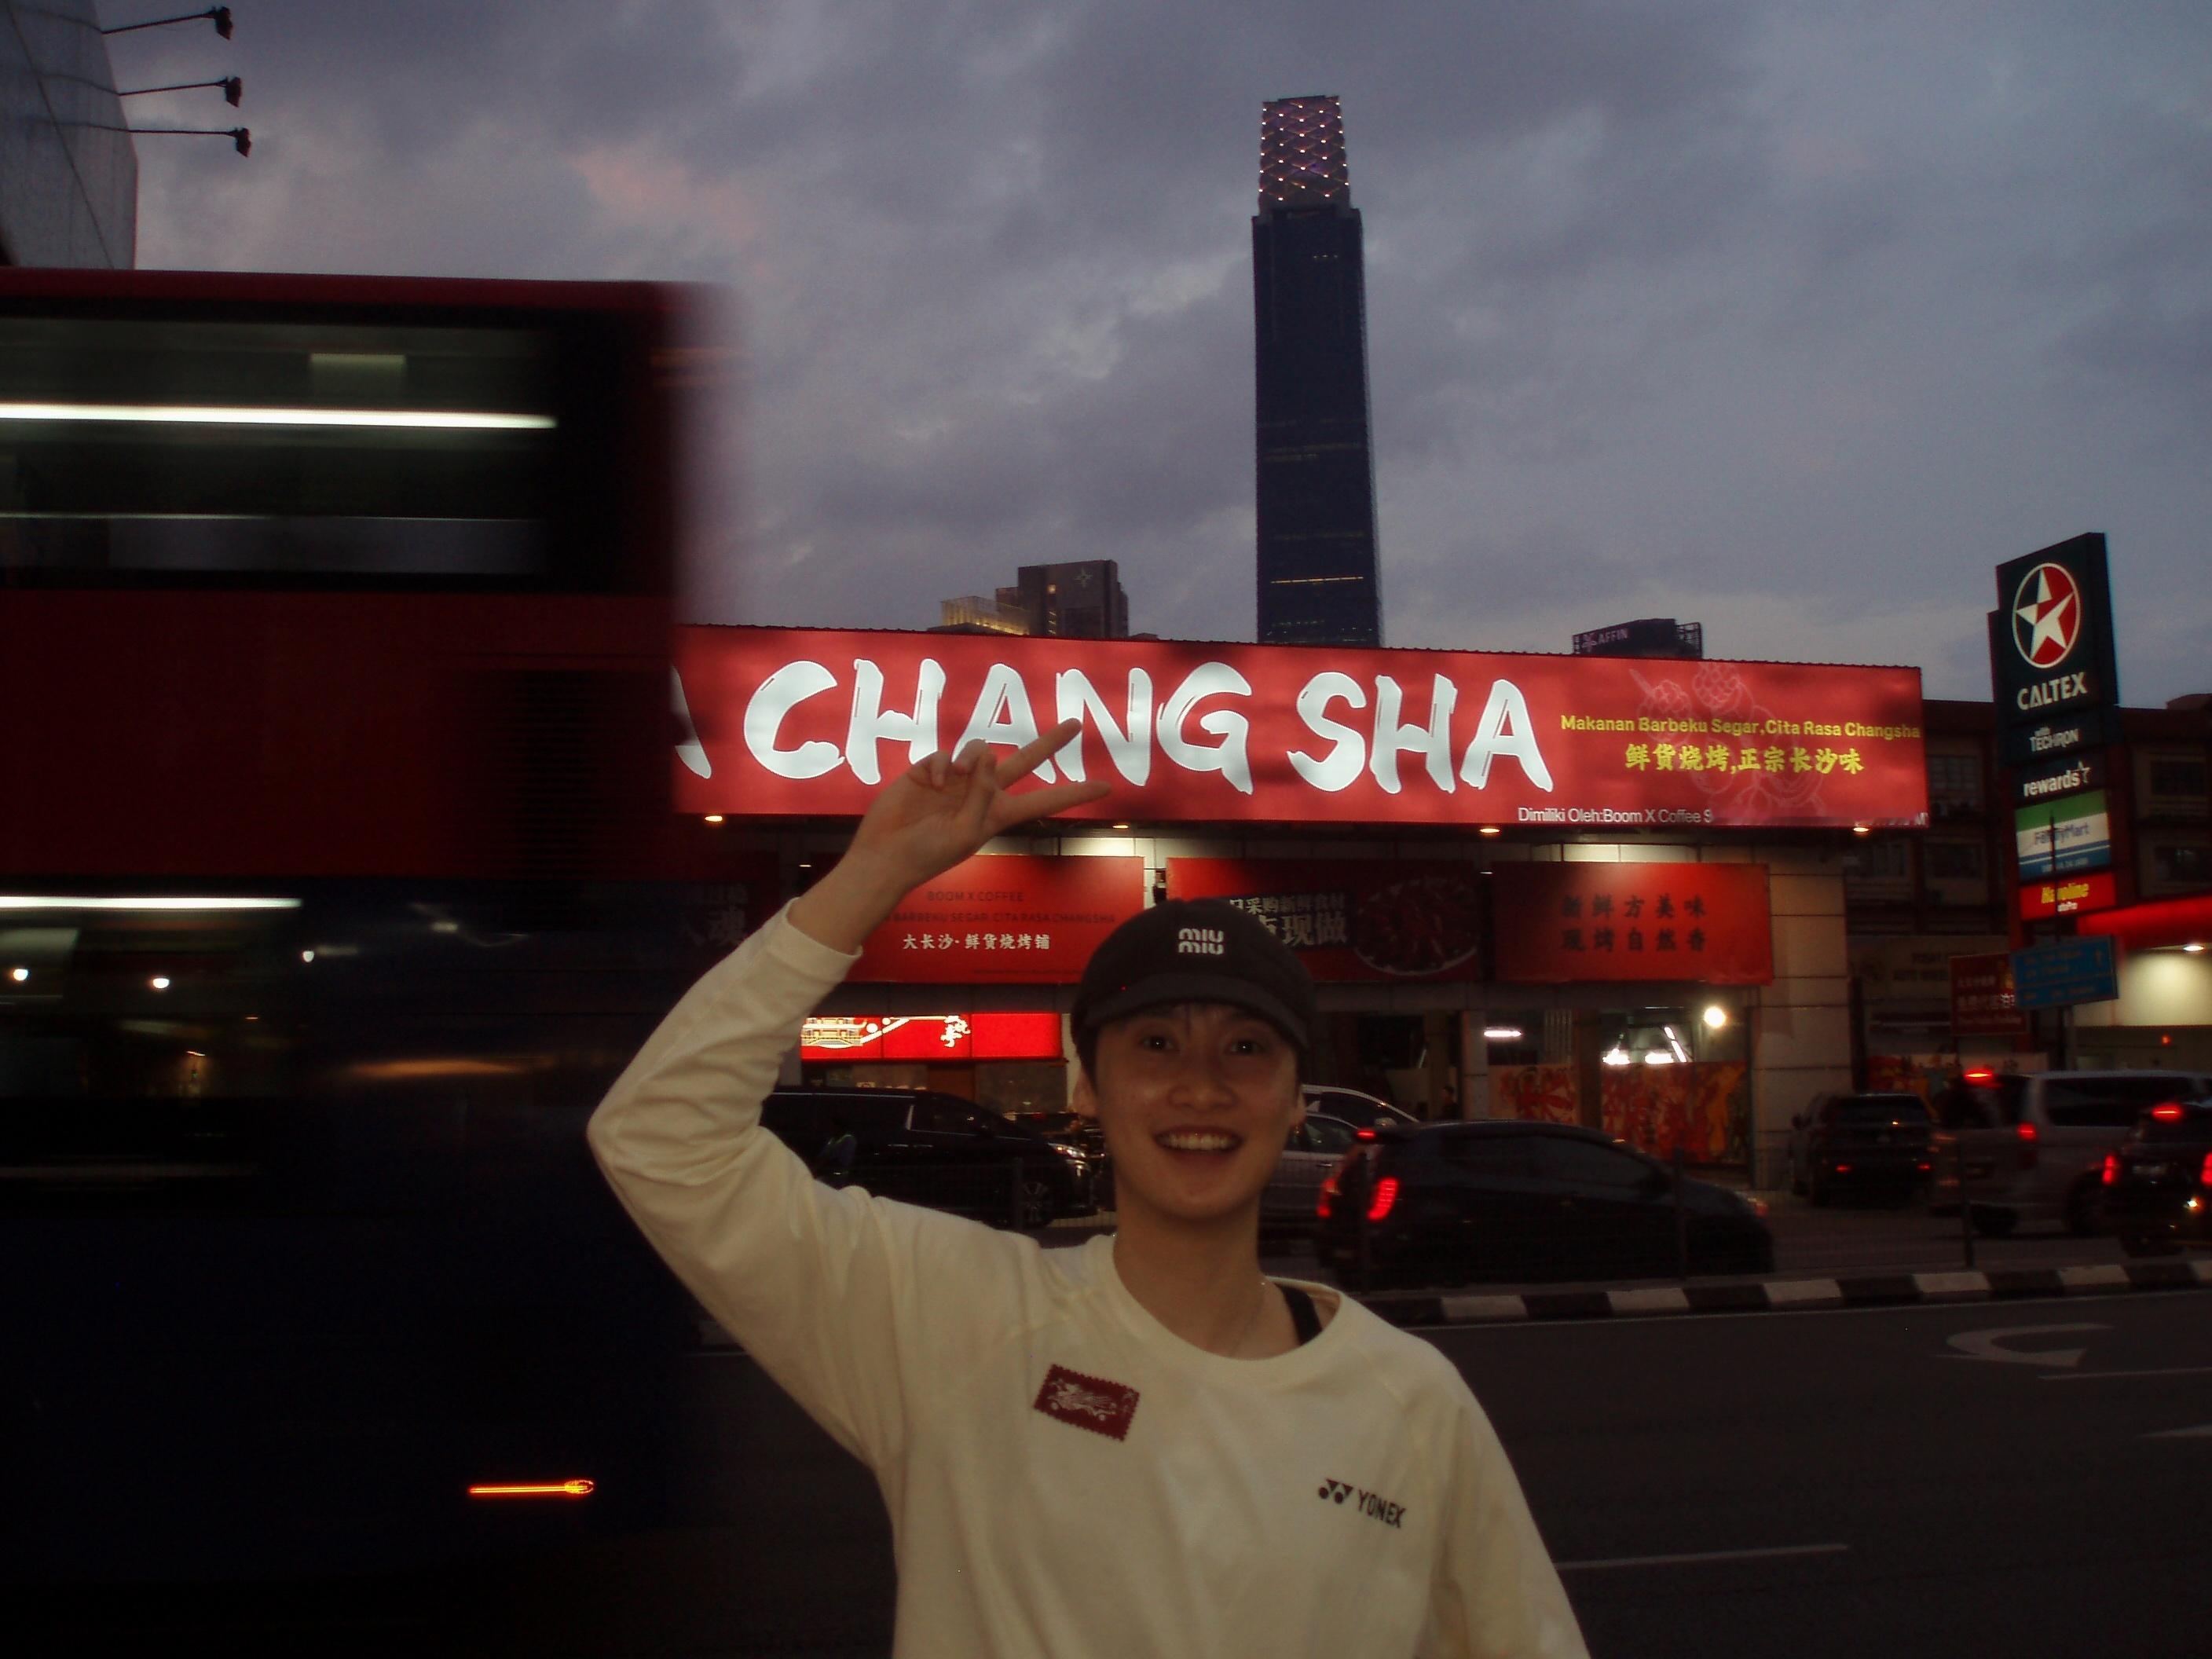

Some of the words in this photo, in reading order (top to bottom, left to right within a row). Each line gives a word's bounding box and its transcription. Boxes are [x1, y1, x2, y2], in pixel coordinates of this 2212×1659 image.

[1599, 628, 1628, 645] AFFIN
[2016, 671, 2089, 712] CALTEX
[742, 659, 1254, 796] CHANG
[1286, 671, 1555, 794] SHA
[1560, 715, 1635, 731] Makanan
[1638, 716, 1708, 733] Barbeku
[1803, 720, 1843, 736] Rasa
[1844, 722, 1921, 741] Changsha
[2028, 727, 2081, 753] TECHRON
[2023, 769, 2082, 797] rewards
[1517, 808, 1566, 822] Dimiliki
[1645, 810, 1657, 822] X
[1657, 810, 1701, 823] Coffee
[927, 890, 965, 901] BOOM
[978, 891, 1025, 902] COFFEE
[1357, 1489, 1407, 1529] YONEX
